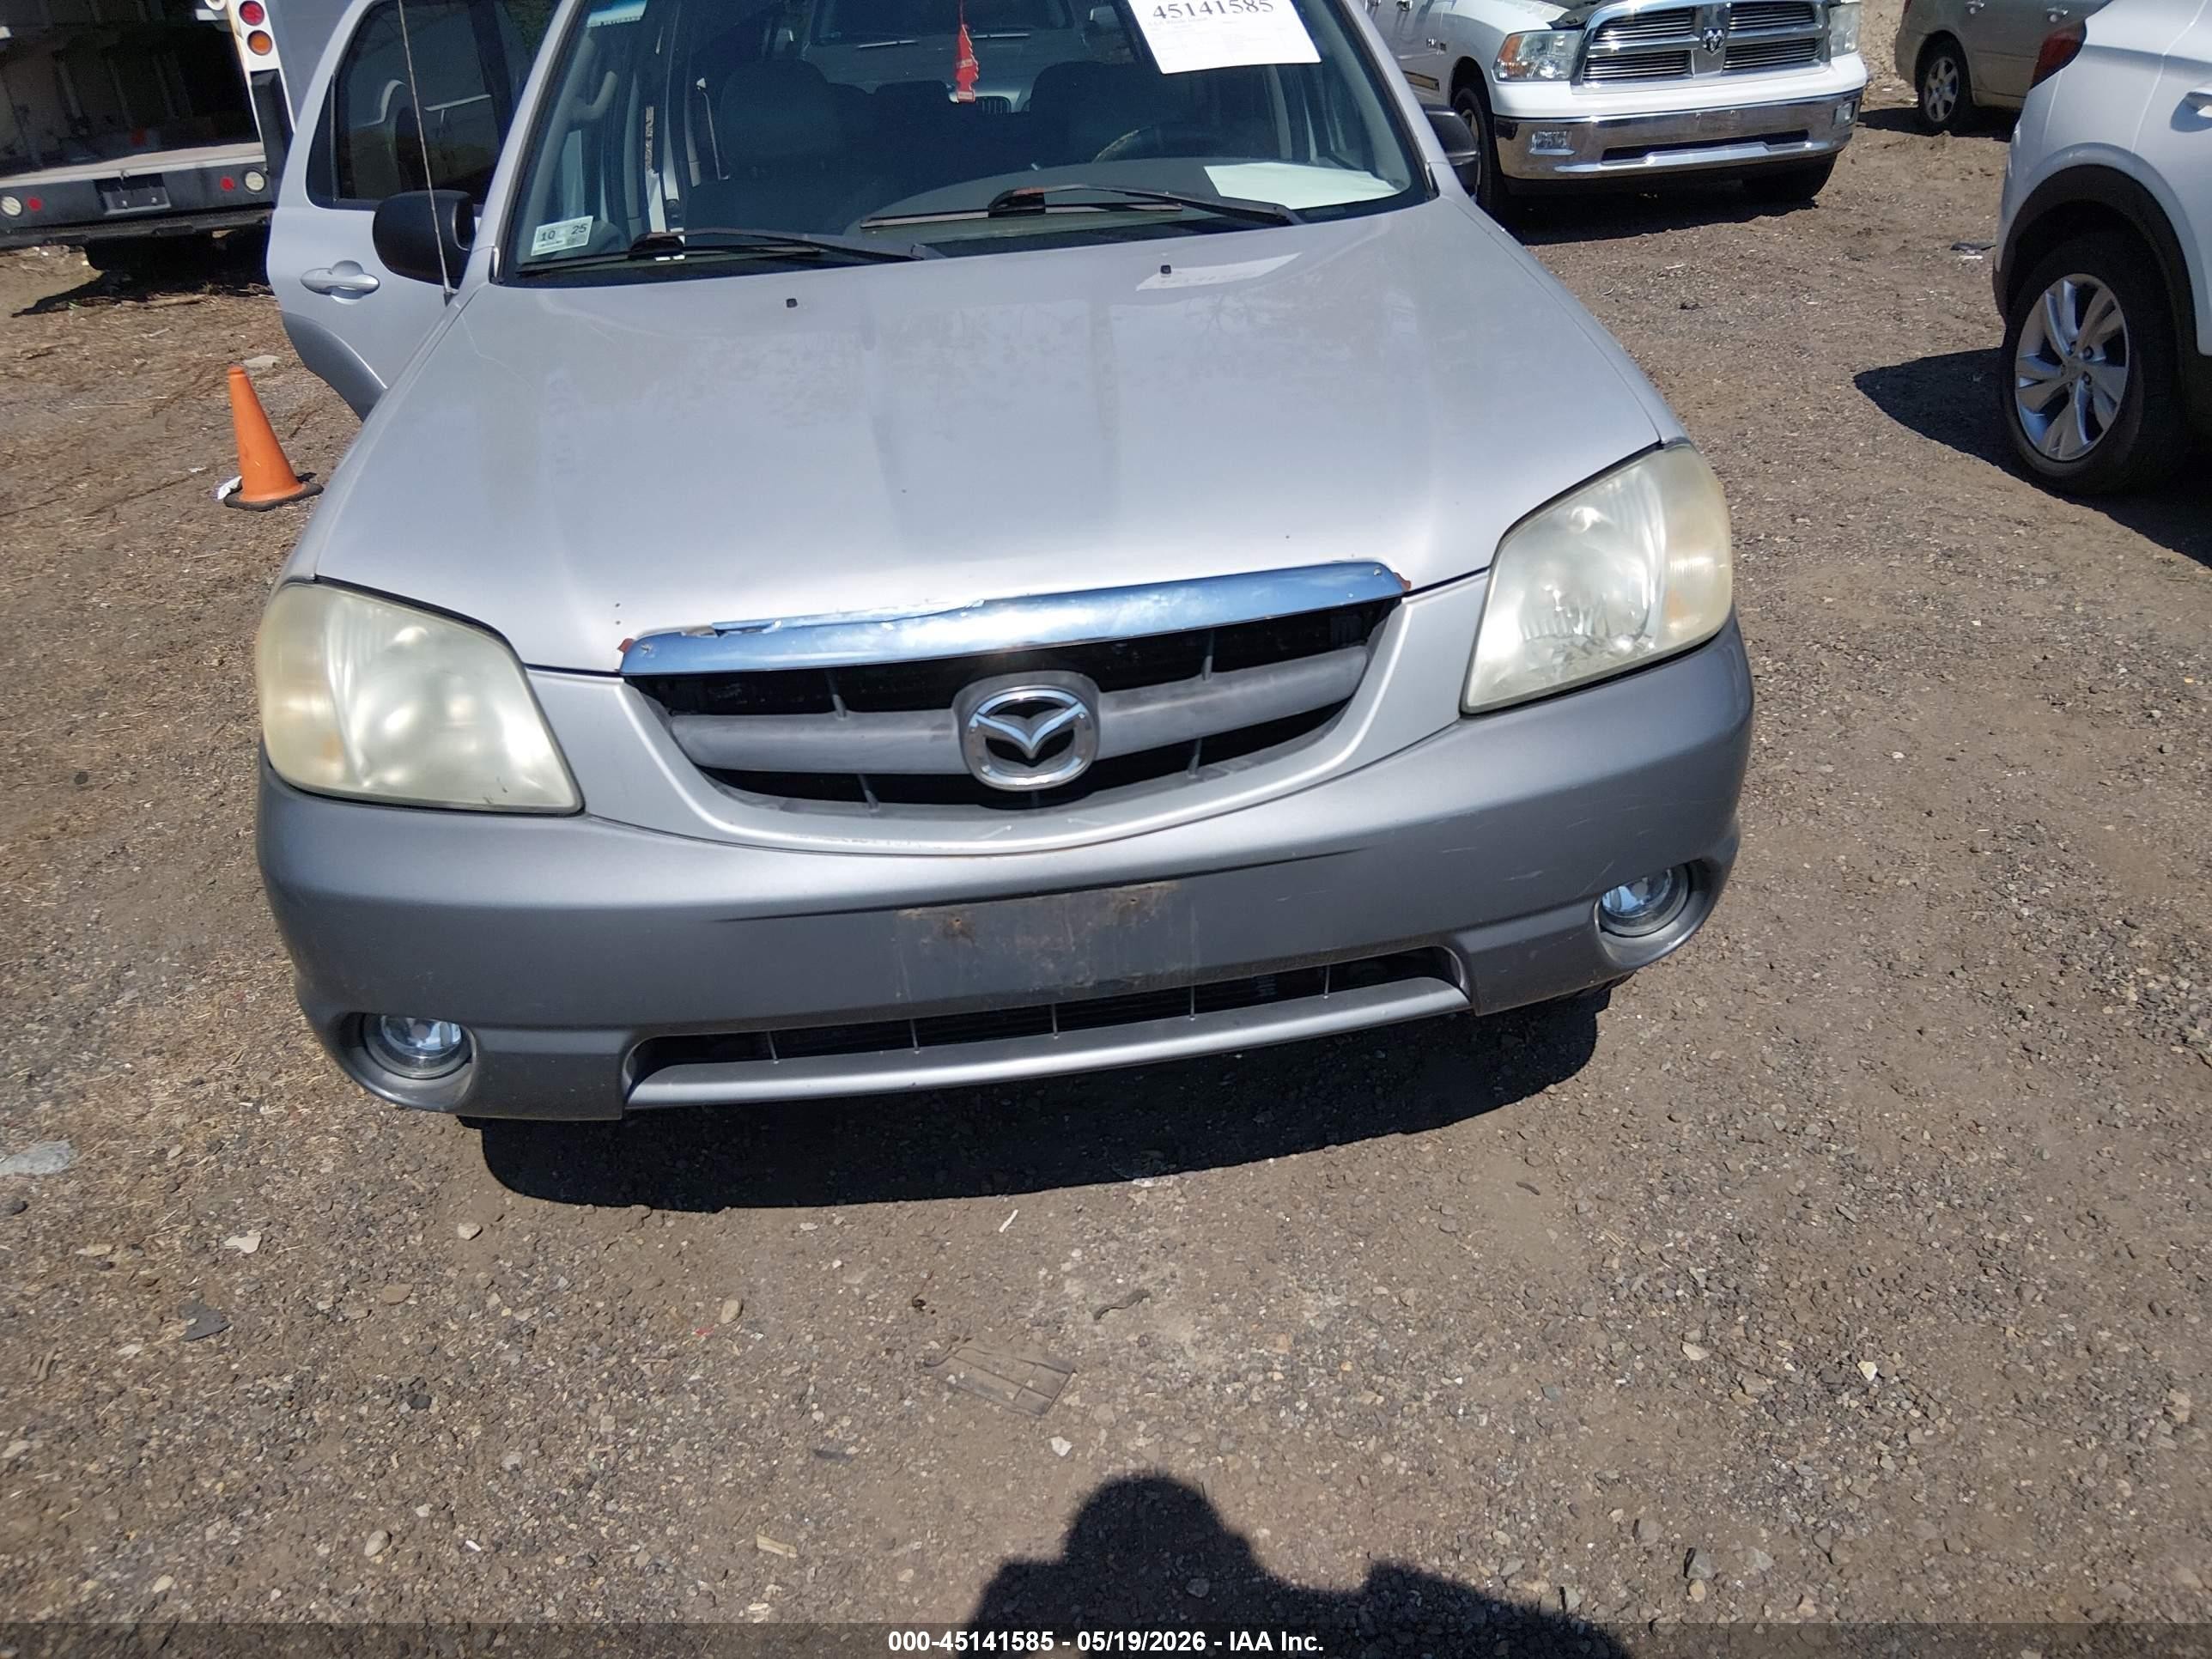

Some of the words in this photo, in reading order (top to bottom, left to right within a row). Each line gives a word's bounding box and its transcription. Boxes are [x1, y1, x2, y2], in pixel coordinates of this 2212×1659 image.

[1152, 0, 1274, 19] 45141585
[540, 230, 556, 241] 10
[571, 223, 588, 234] 25
